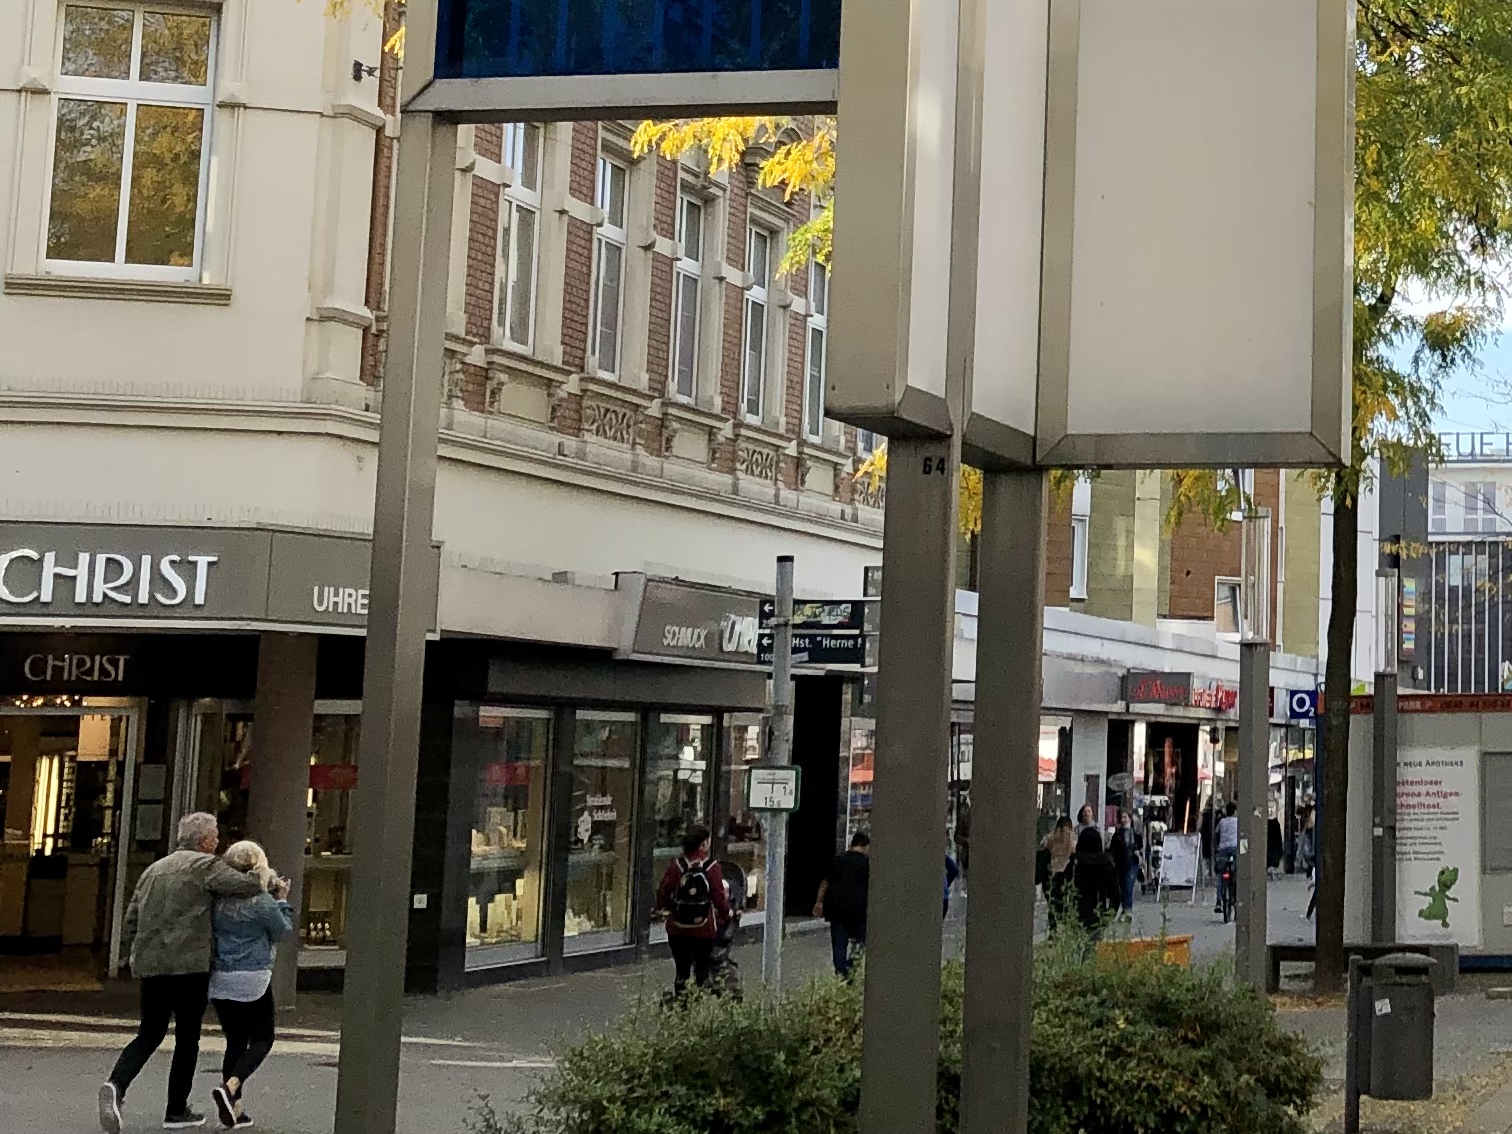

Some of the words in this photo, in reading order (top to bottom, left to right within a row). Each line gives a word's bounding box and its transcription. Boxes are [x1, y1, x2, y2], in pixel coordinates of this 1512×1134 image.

[1437, 432, 1494, 457] EUE
[922, 457, 946, 475] 64
[0, 548, 218, 606] CHRIST
[312, 585, 369, 615] UHRE
[663, 624, 708, 649] SCHMUCK
[792, 637, 813, 648] Hst.
[24, 653, 131, 682] CHRIST
[1292, 692, 1315, 717] O2
[1396, 778, 1442, 787] ostenloser
